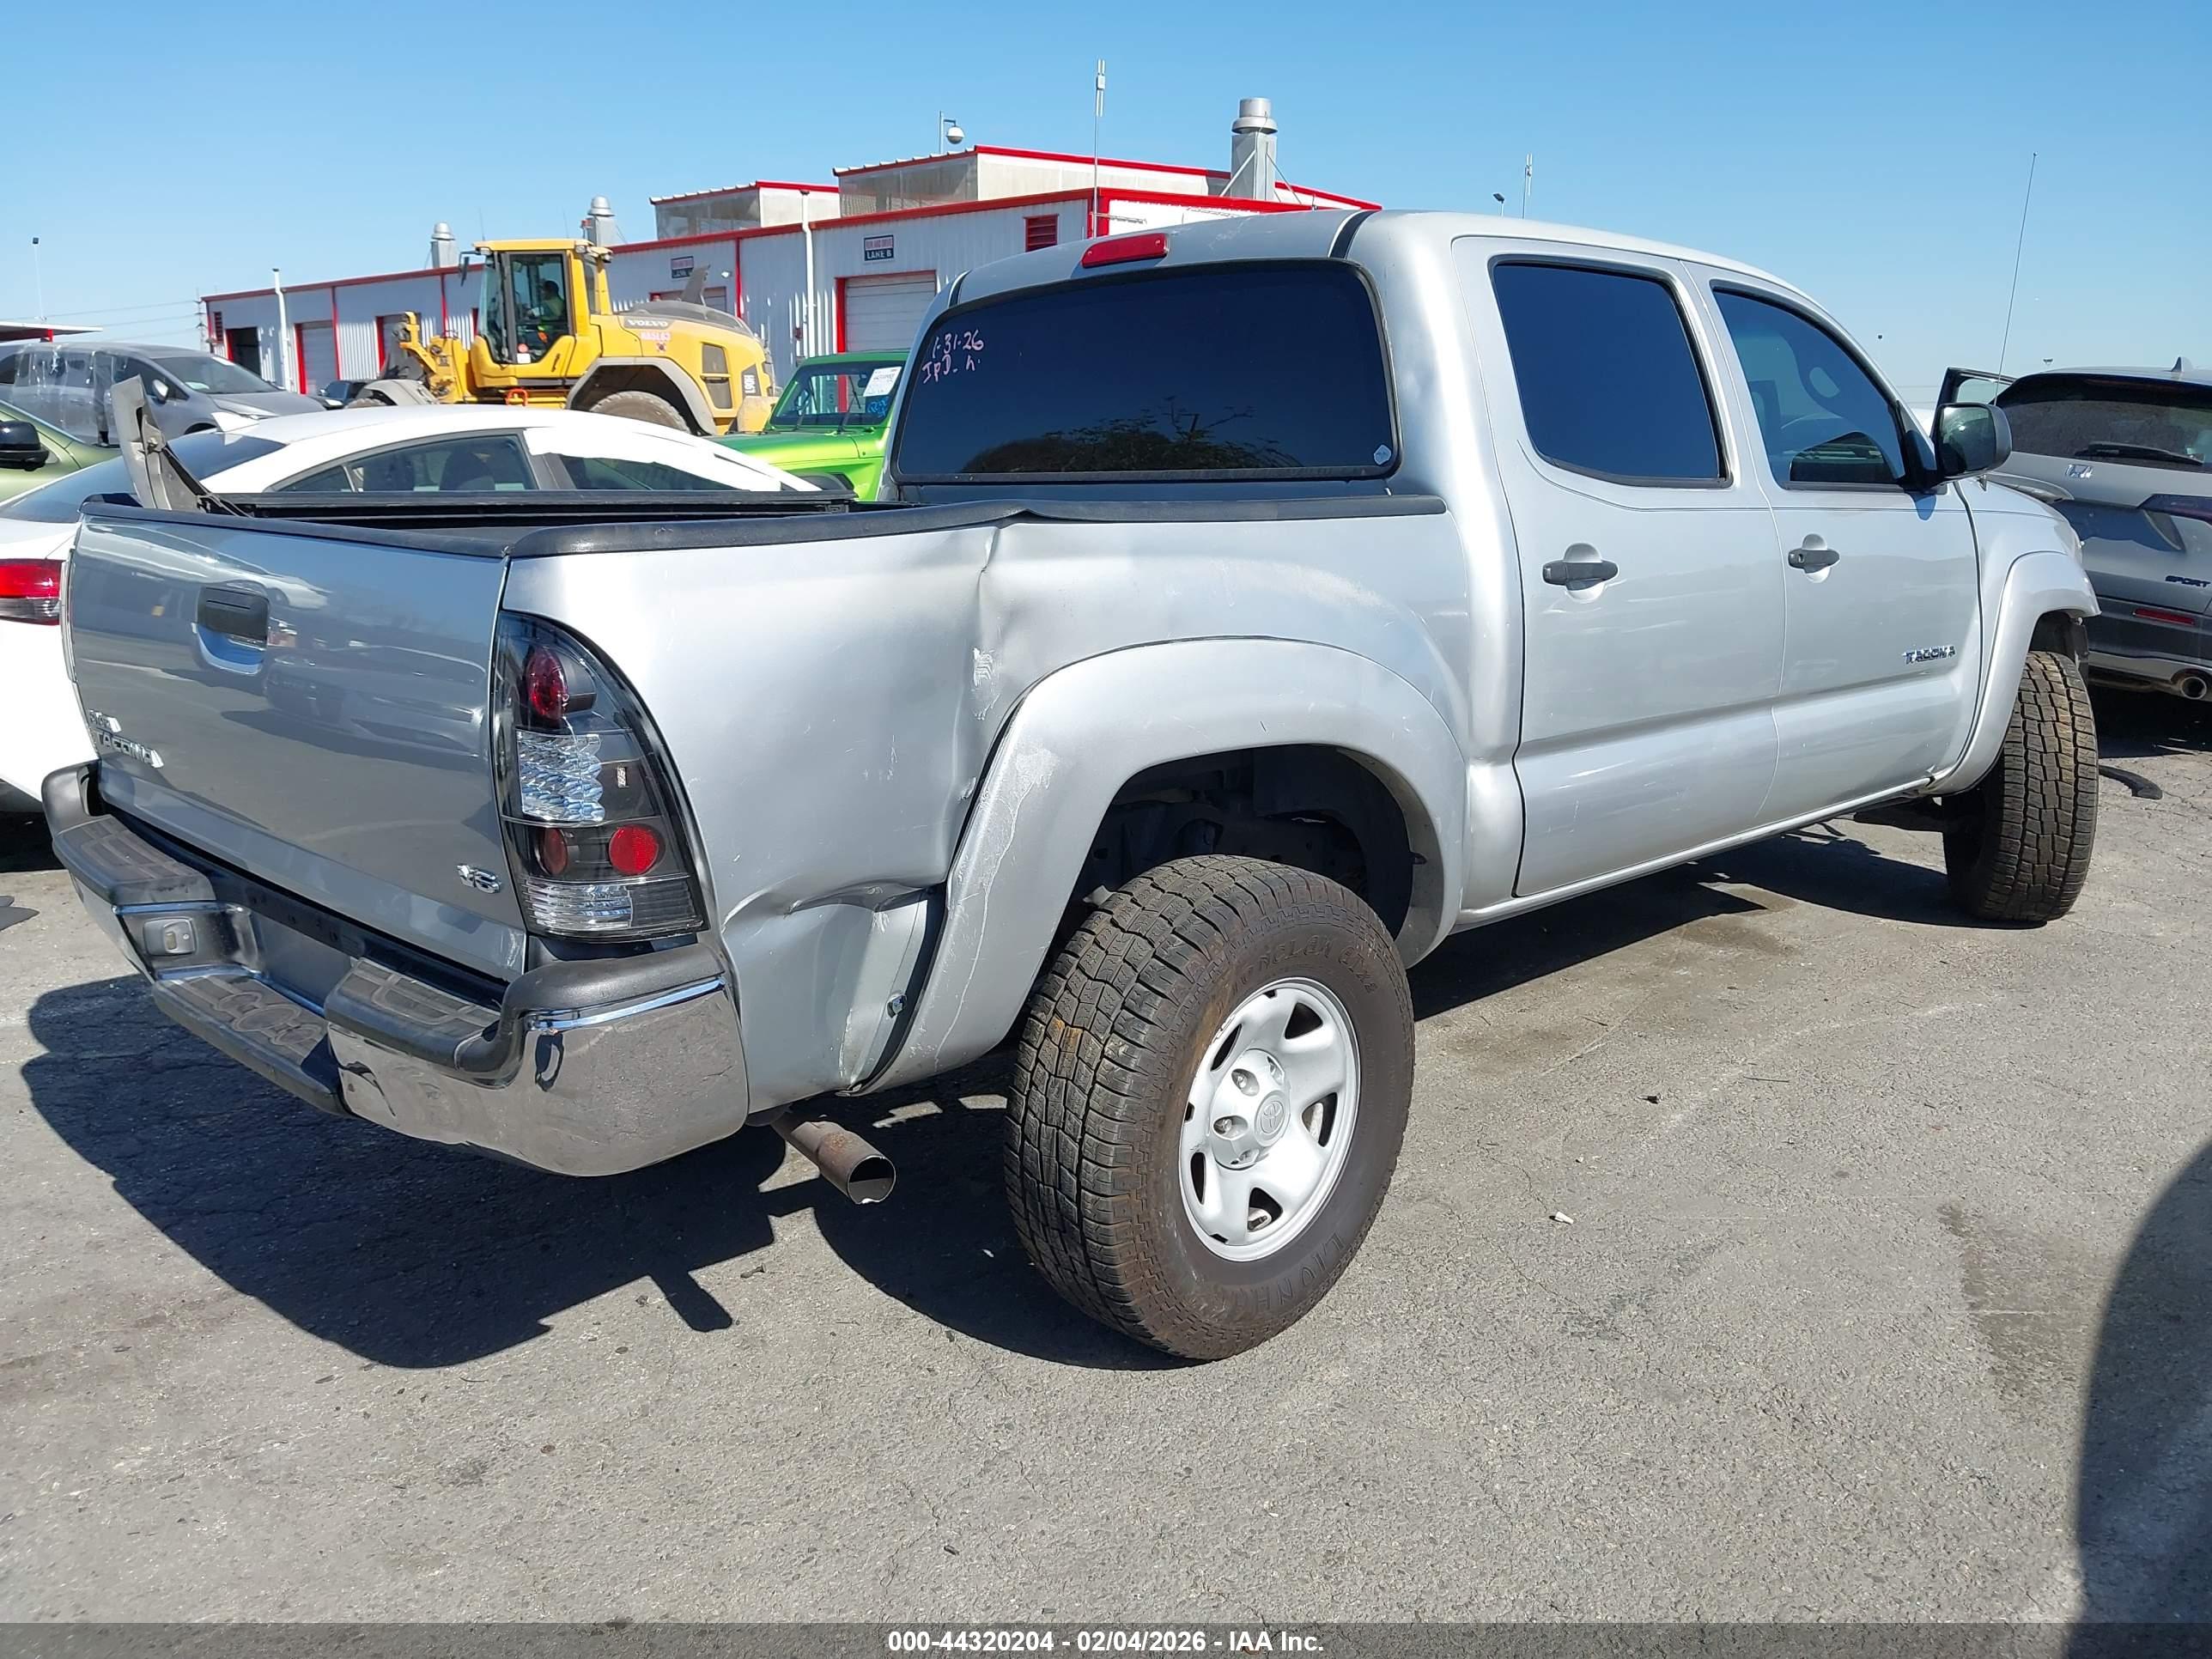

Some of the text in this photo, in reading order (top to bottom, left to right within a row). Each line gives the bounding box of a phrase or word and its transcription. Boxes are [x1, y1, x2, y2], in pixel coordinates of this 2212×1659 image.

[866, 250, 885, 260] LANE
[627, 319, 669, 327] VOLVO
[743, 374, 757, 394] L90H
[2164, 574, 2211, 588] SPORT
[1902, 646, 1956, 665] TACOMA
[93, 726, 164, 769] TACOMA
[456, 864, 501, 894] V6
